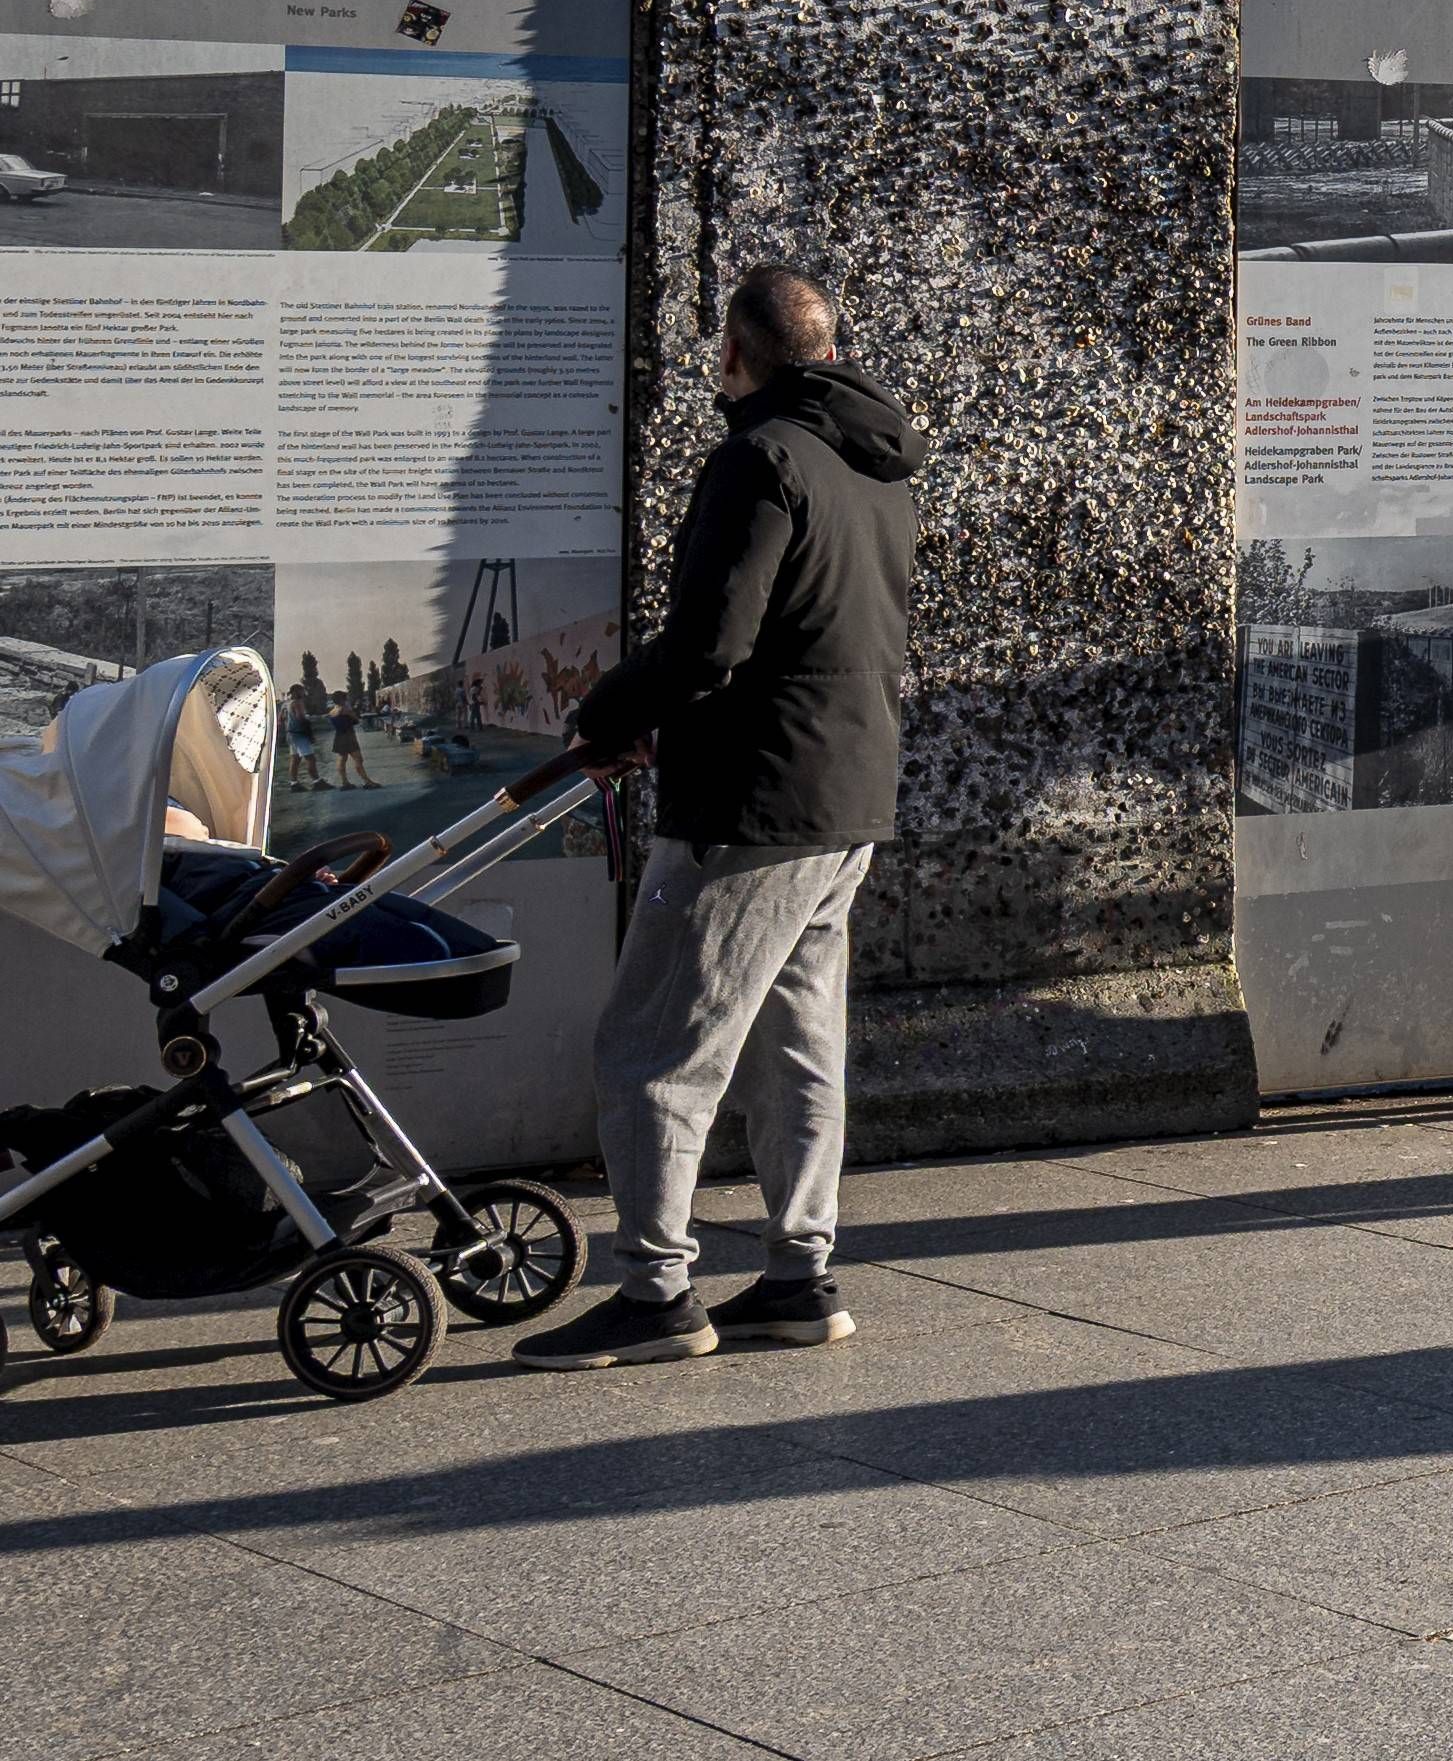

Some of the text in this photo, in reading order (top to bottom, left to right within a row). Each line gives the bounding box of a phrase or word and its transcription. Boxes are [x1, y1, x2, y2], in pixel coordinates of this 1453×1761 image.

[287, 5, 357, 19] New Parks
[1246, 316, 1312, 326] Grünes Band
[1246, 337, 1337, 347] The Green Ribbon
[1245, 396, 1361, 409] Am Heidekampgraben/
[1245, 412, 1326, 422] Landschaftspark
[1245, 426, 1359, 436] Adlershof-Johannisthal
[1244, 445, 1363, 457] Heidekampgraben Park/
[1244, 459, 1358, 471] Adlershof-Johannisthal
[1244, 474, 1324, 485] Landscape Park
[1257, 638, 1344, 664] YOU ARE LEAVING
[1252, 657, 1349, 690] THE AMERICAN SECTOR
[1260, 729, 1326, 773] VOUS SORTEZ
